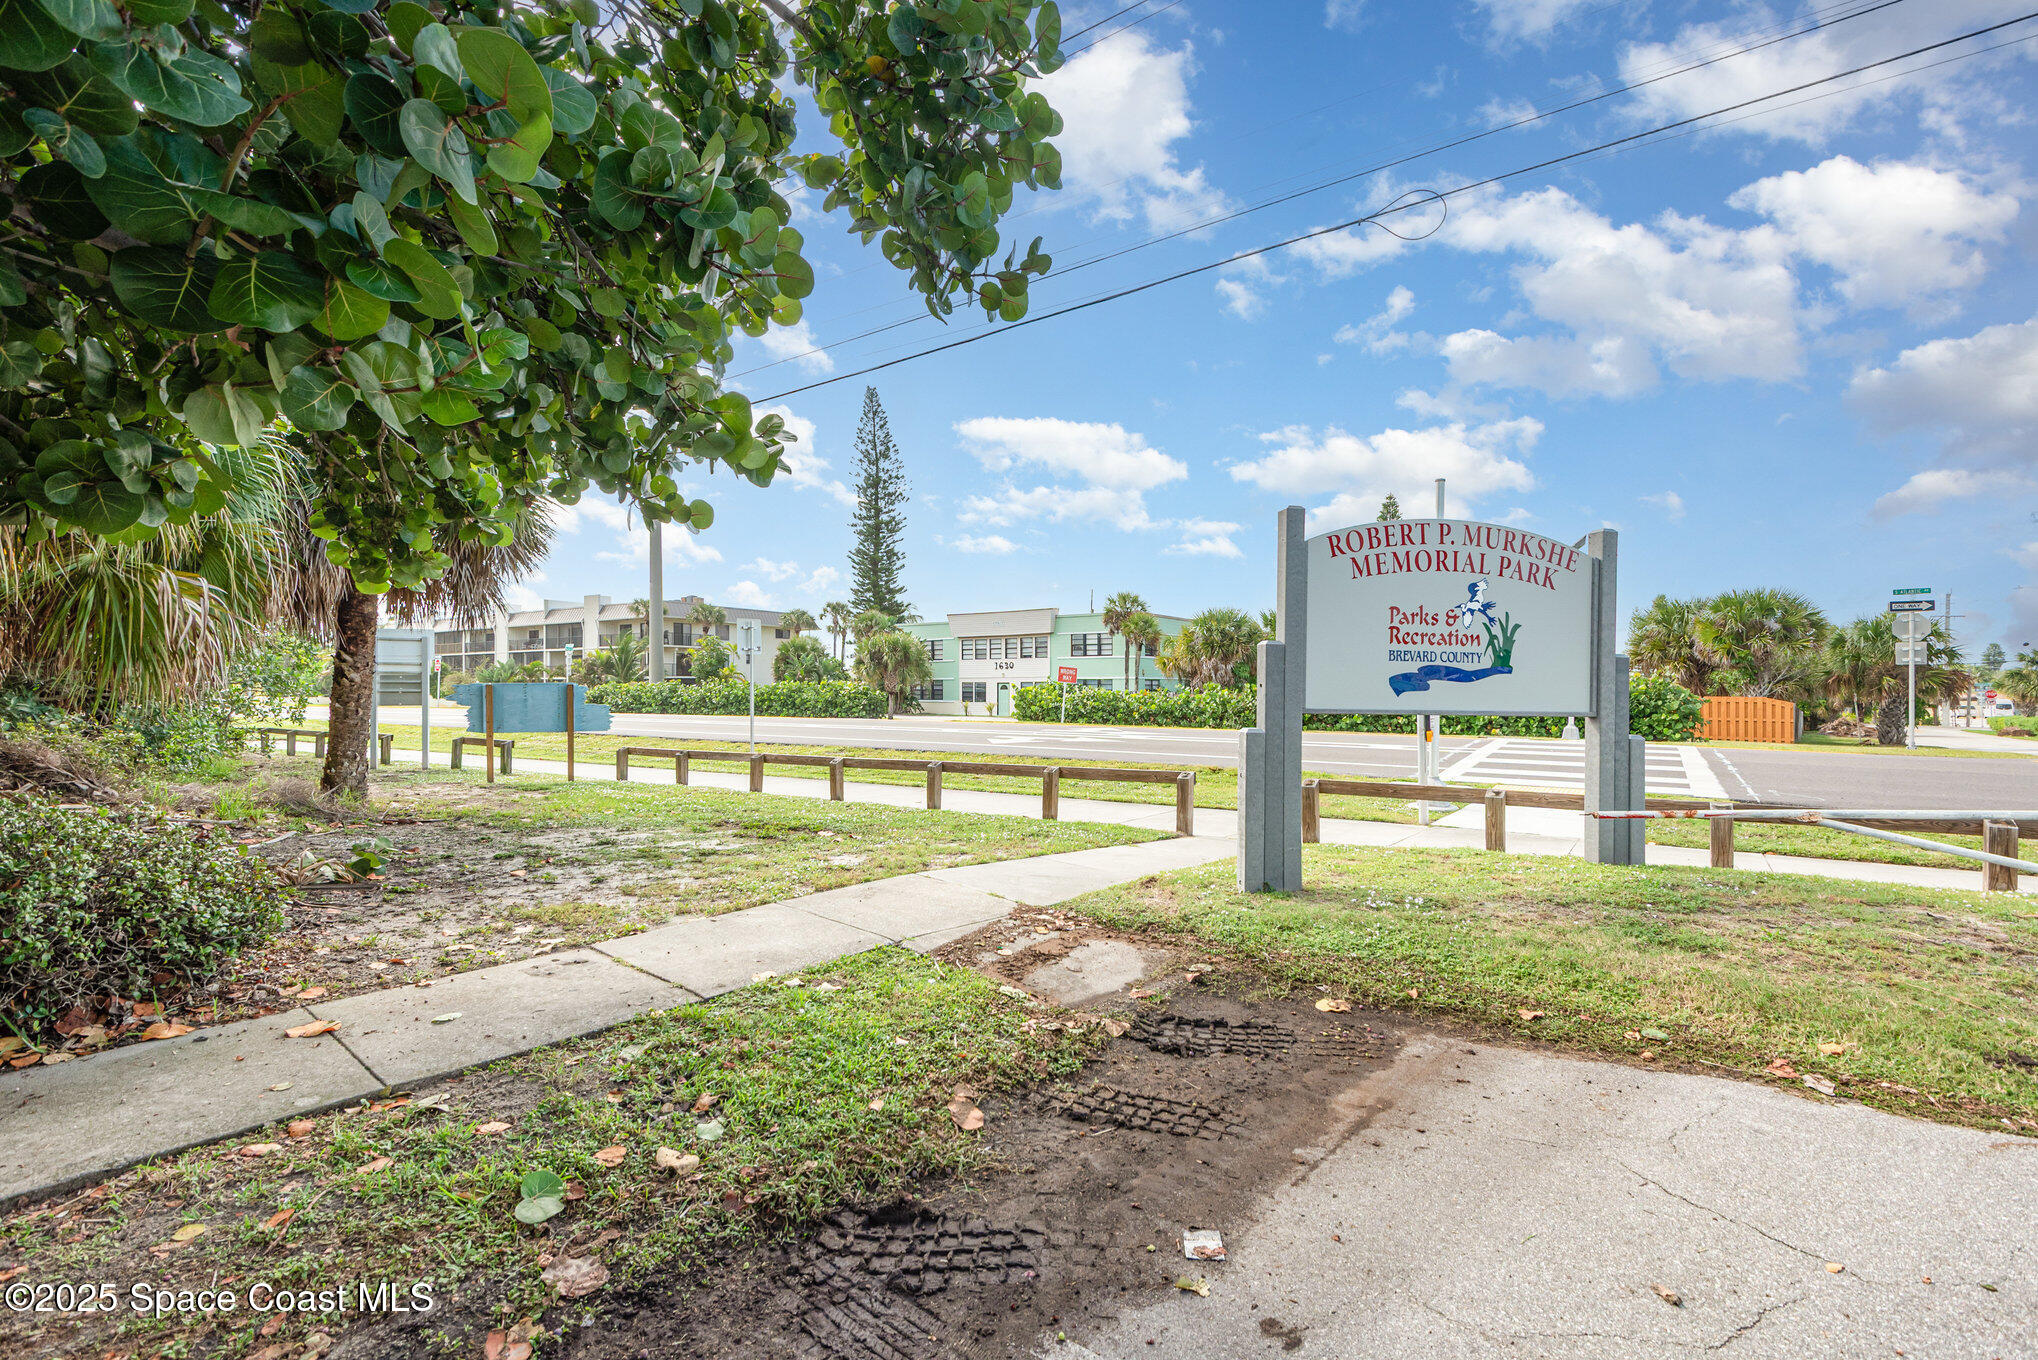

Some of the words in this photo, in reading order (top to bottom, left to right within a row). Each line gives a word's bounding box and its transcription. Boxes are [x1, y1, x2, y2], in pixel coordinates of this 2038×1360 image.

[1327, 522, 1431, 558] ROBERT
[1438, 523, 1455, 546] P.
[1463, 524, 1580, 573] MURKSHE
[1350, 549, 1491, 579] MEMORIAL
[1498, 556, 1560, 591] PARK
[1388, 604, 1439, 626] Parks
[1445, 609, 1460, 626] &
[1388, 625, 1481, 647] Recreation
[1389, 650, 1437, 662] BREVARD
[1440, 651, 1483, 664] COUNTY
